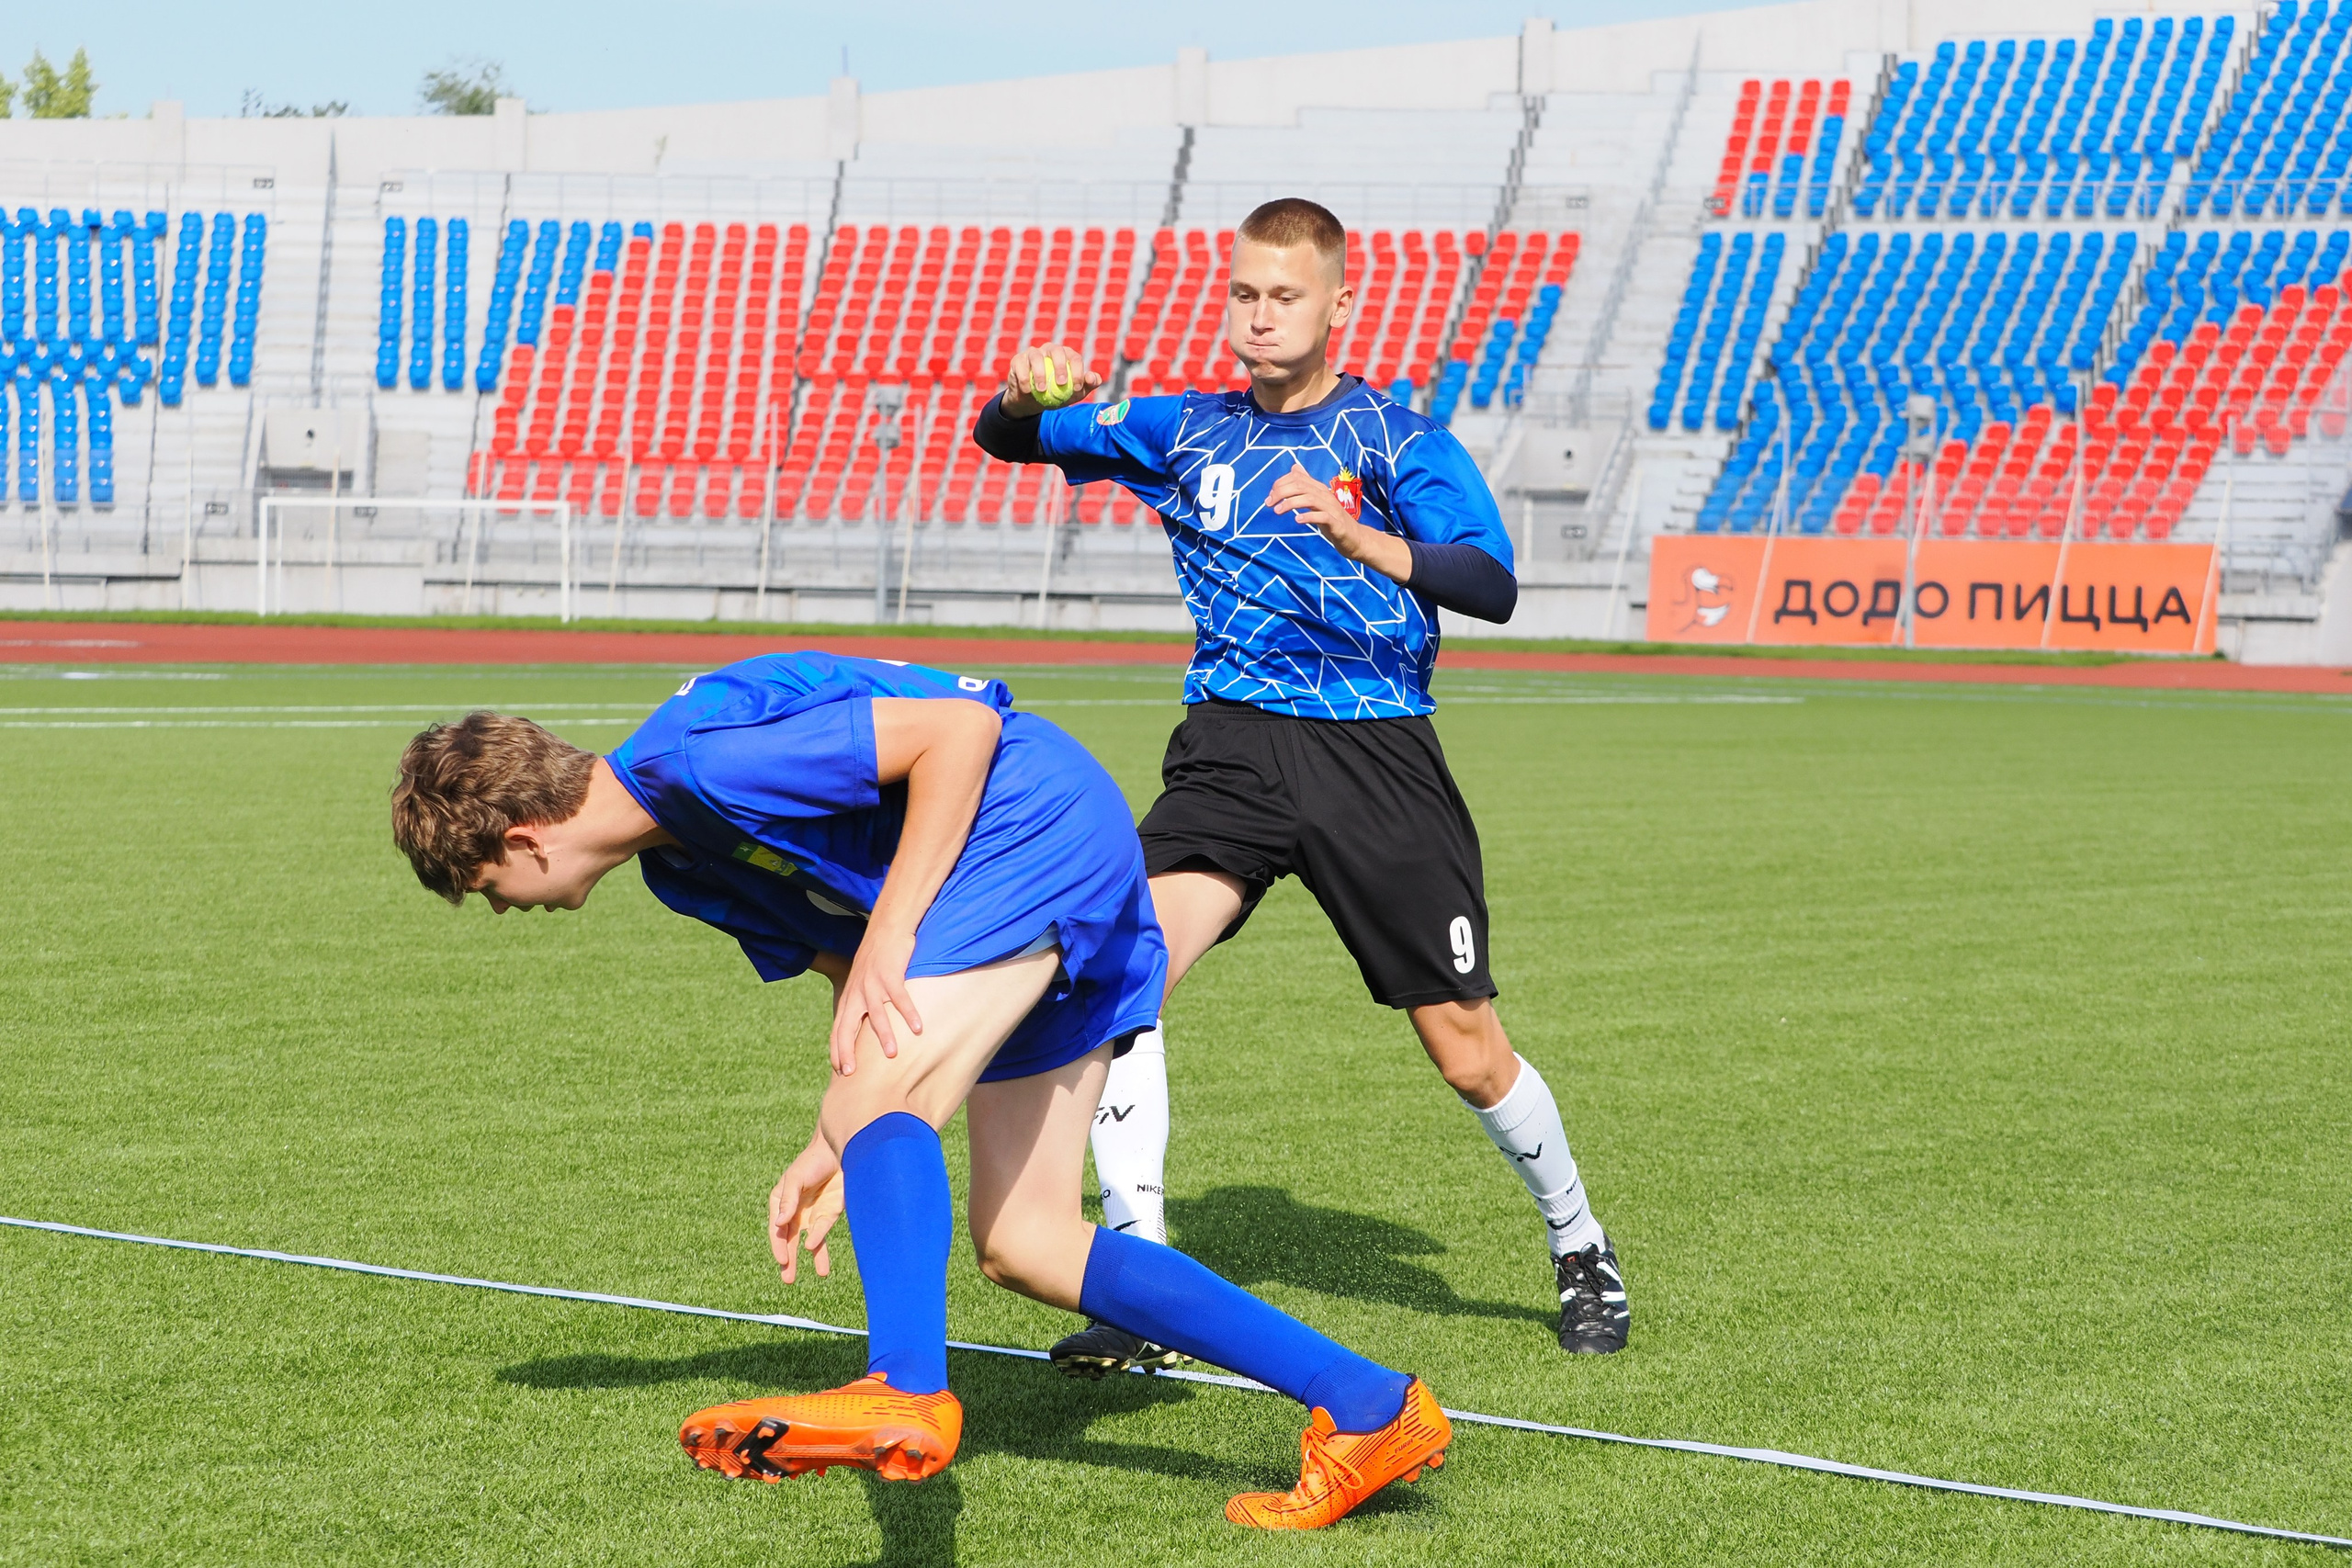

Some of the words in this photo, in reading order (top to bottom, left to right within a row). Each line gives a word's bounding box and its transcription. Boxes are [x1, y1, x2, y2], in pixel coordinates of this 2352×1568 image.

[1198, 463, 1235, 531] 9
[1774, 580, 1950, 626] ДОДО
[1969, 582, 2191, 633] ПИЦЦА
[1449, 916, 1476, 974] 9
